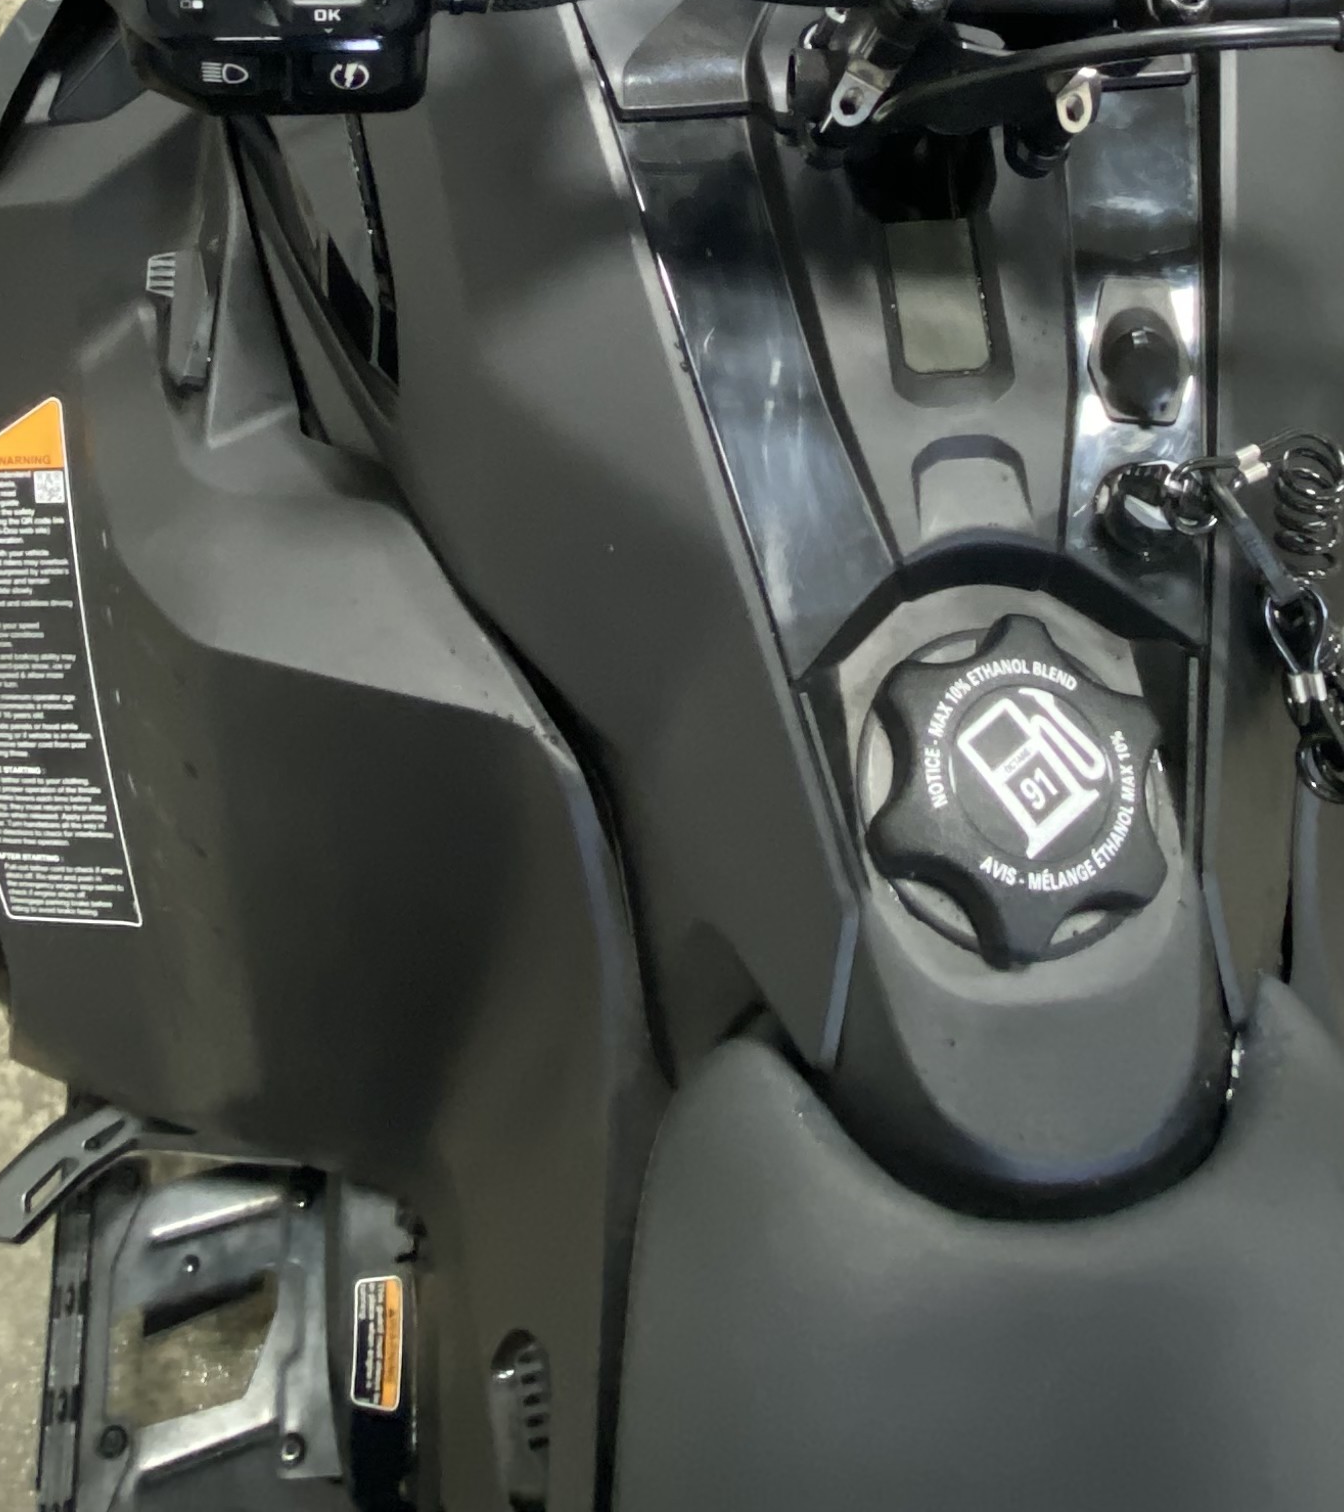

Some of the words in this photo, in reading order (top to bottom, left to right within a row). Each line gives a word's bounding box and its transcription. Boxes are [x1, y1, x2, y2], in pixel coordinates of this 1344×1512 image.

[313, 9, 342, 22] OK
[966, 658, 1030, 686] ETHANOL
[1032, 661, 1078, 691] BLEND
[945, 678, 971, 705] 10%
[928, 701, 954, 738] MAX
[1109, 730, 1131, 761] 10%
[924, 747, 949, 809] NOTICE
[1019, 767, 1059, 810] 91
[1119, 764, 1136, 803] MAX
[1091, 805, 1135, 870] ÉTHANOL
[979, 856, 1017, 886] AVIS
[1027, 859, 1097, 892] MÉLANGE
